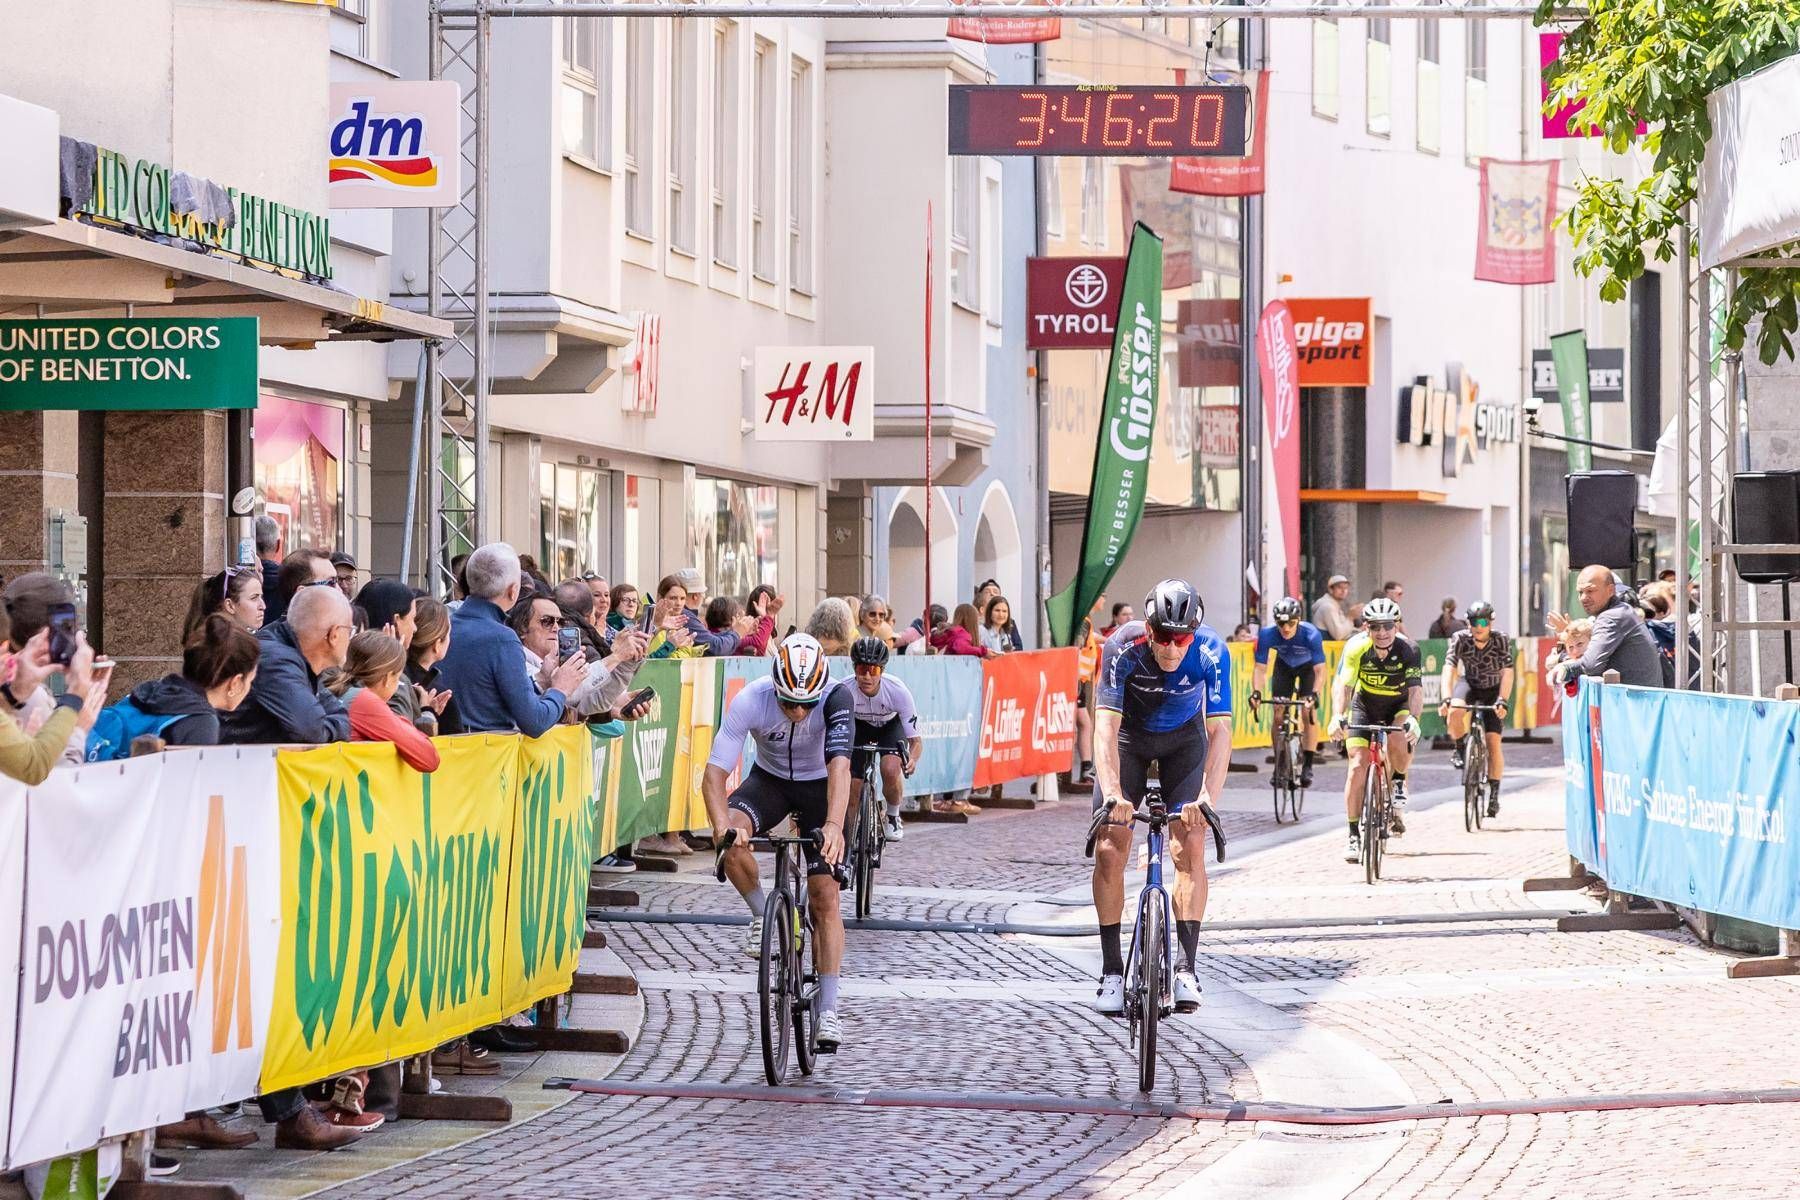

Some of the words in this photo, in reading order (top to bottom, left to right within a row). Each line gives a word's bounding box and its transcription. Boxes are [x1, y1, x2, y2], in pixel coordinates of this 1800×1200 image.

[330, 102, 422, 157] dm
[1016, 94, 1224, 147] 3:46:20
[0, 328, 99, 350] UNITED
[107, 326, 221, 350] COLORS
[1294, 316, 1365, 347] giga
[1296, 344, 1362, 364] sport
[0, 358, 34, 382] OF
[41, 357, 191, 382] BENETTON.
[765, 361, 862, 426] H&M
[1110, 302, 1152, 461] Gösser
[1112, 469, 1135, 530] BESSER
[1104, 535, 1121, 567] GUT
[113, 990, 194, 1079] BANK
